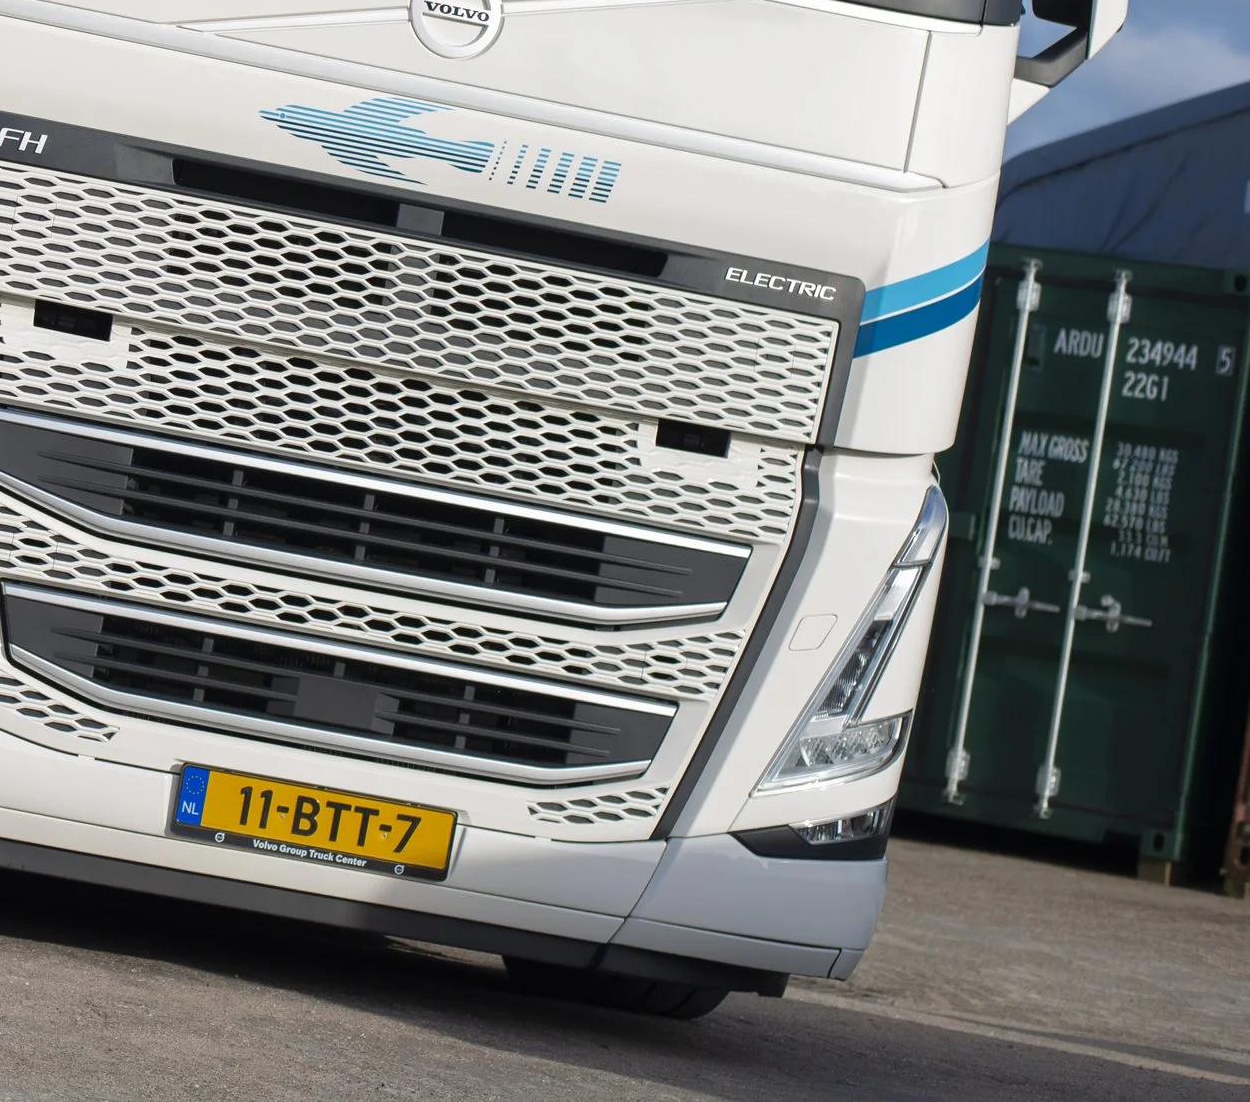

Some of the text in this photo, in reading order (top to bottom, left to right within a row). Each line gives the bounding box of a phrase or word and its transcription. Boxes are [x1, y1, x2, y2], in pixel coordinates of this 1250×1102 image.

[423, 0, 490, 22] VOLVO
[725, 266, 837, 301] ELECTRIC
[1053, 328, 1104, 359] ARDU
[1125, 336, 1199, 371] 234944
[1122, 370, 1169, 402] 22G1
[1019, 430, 1090, 464] MAX GROSS
[1015, 456, 1046, 487] TARE
[1008, 485, 1066, 518] PAYLOAD
[181, 800, 199, 816] NL
[238, 785, 423, 854] 11-BTT-7
[253, 838, 367, 867] Volvo Group Truck Center
